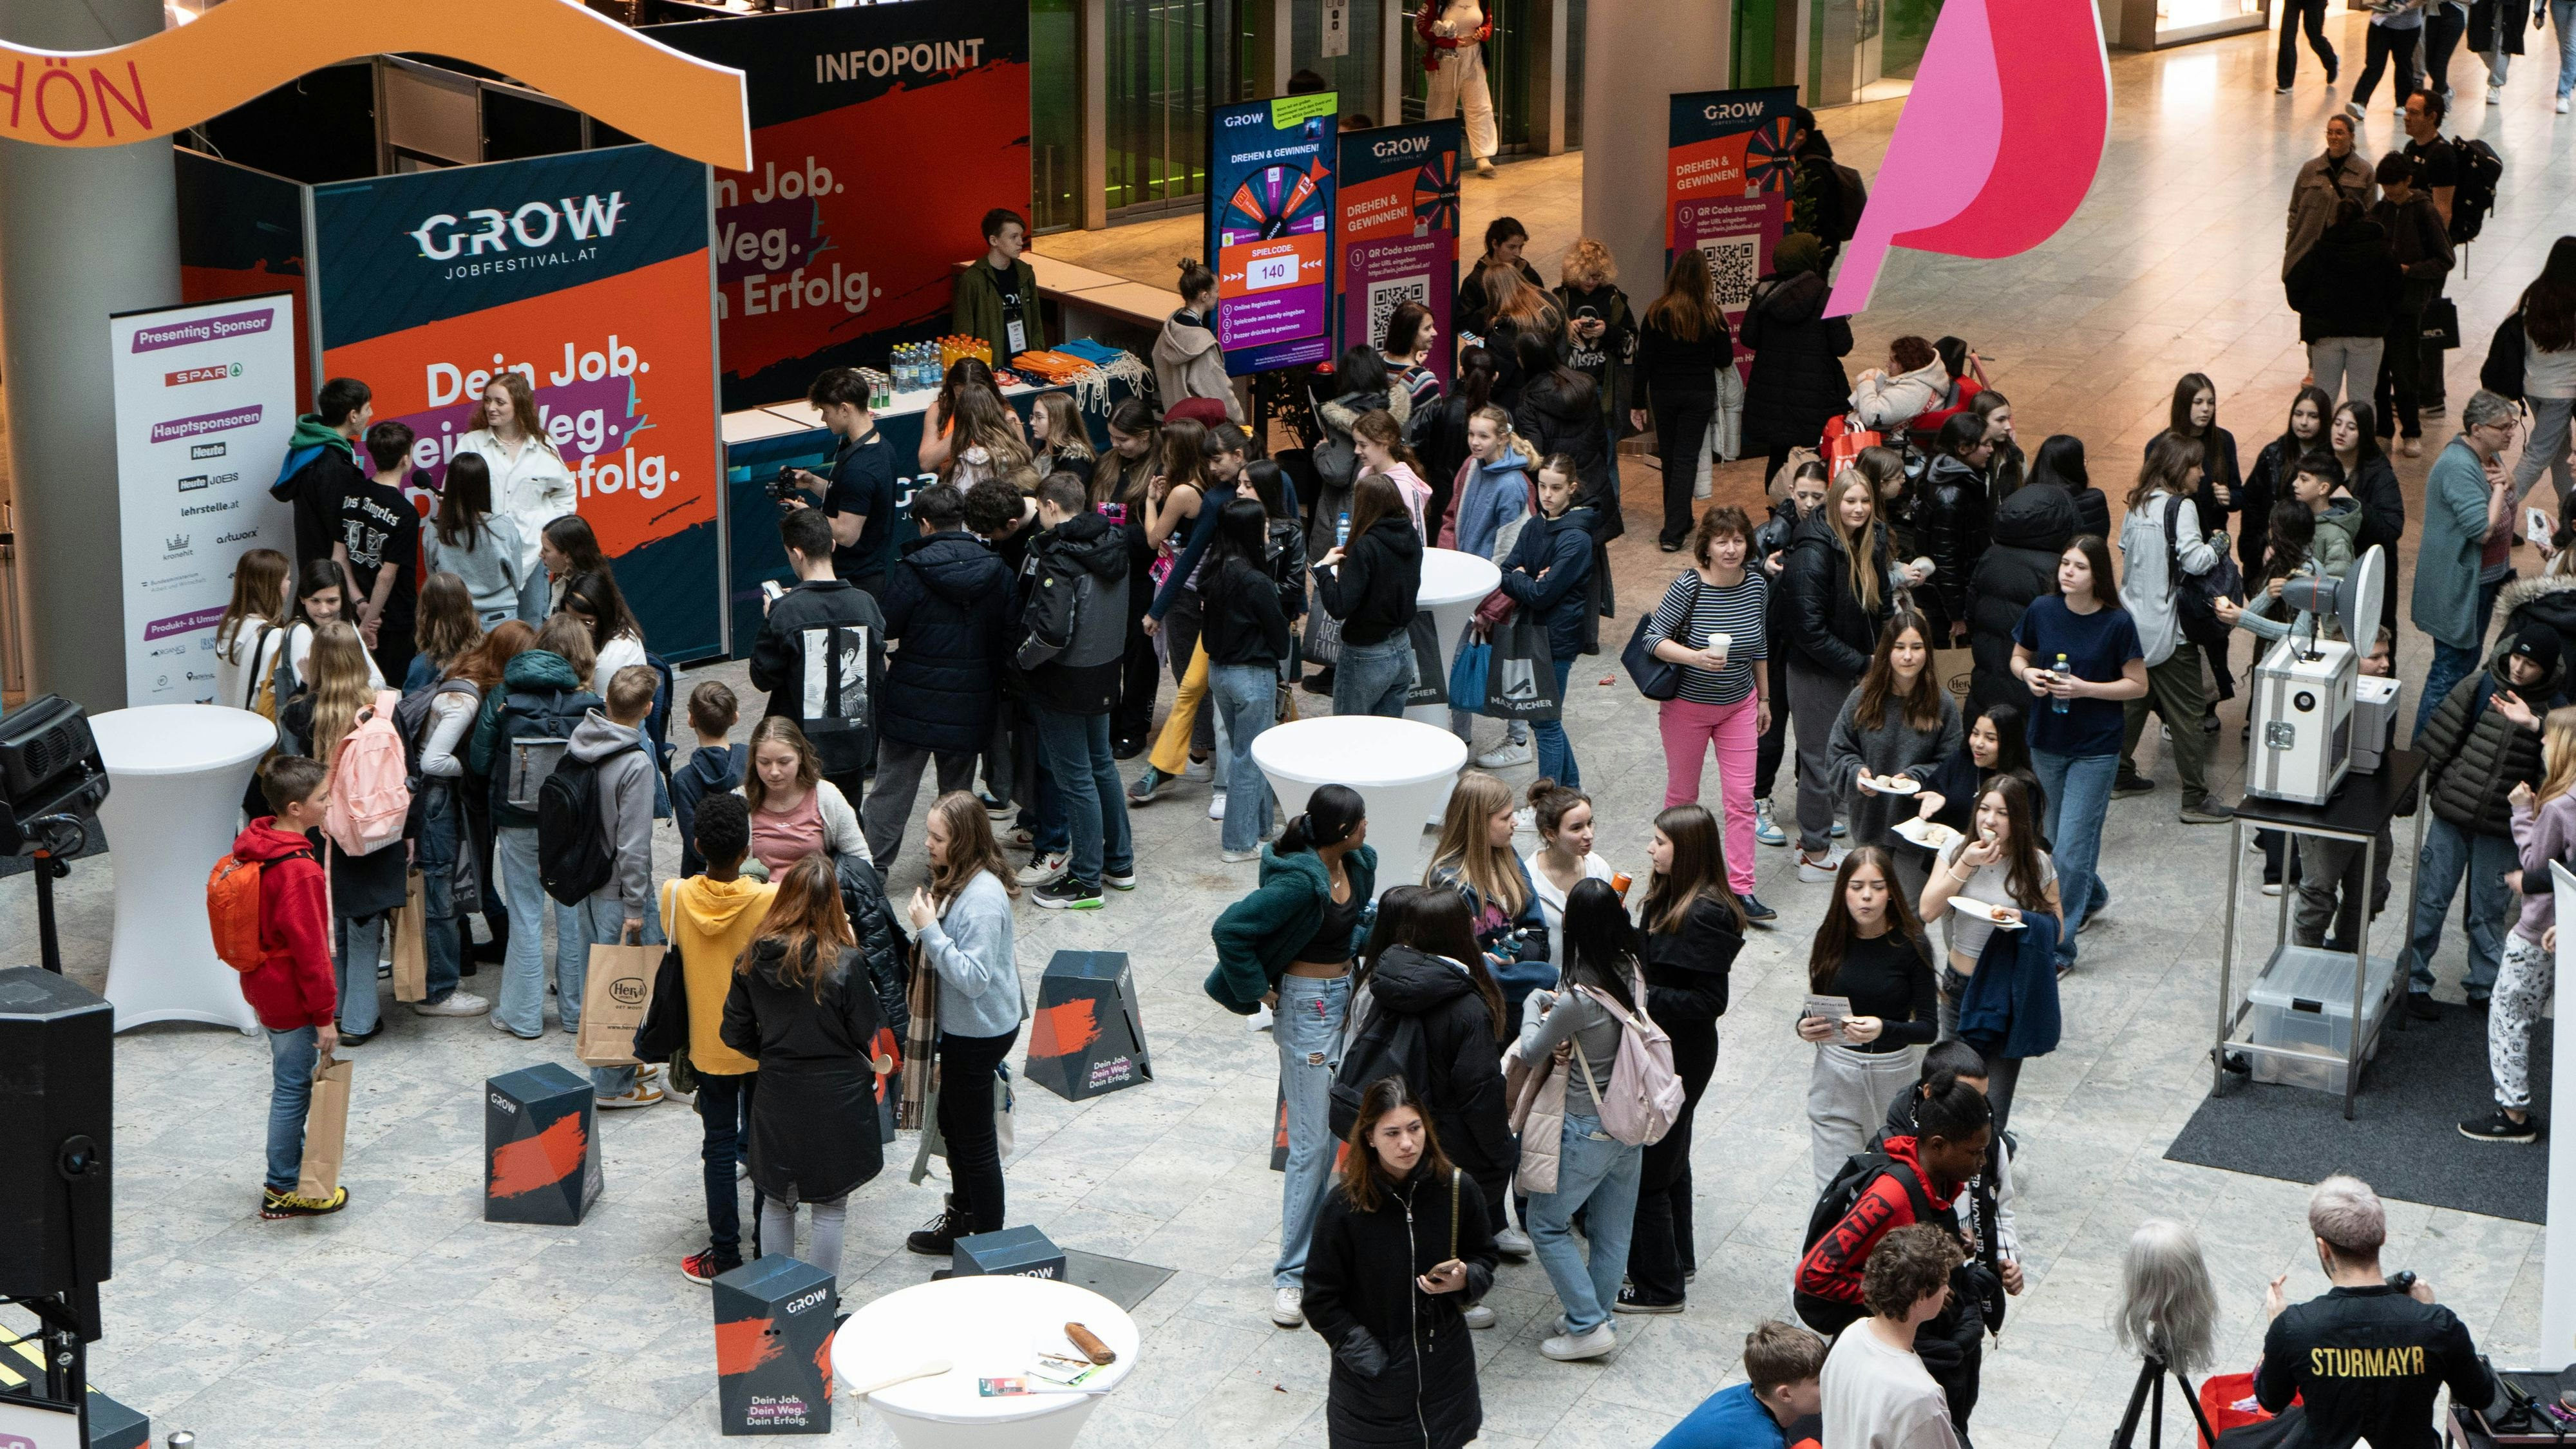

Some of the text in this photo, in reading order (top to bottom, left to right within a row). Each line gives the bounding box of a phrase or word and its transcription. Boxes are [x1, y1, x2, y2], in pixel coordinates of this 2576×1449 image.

[816, 38, 984, 83] INFOPOINT
[1703, 101, 1764, 119] GROW
[1224, 113, 1264, 127] GROW
[1231, 144, 1319, 163] DREHEN & GEWINNEN!
[1372, 136, 1430, 156] GROW
[1676, 156, 1728, 176] DREHEN &
[752, 156, 844, 204] Job.
[1677, 168, 1739, 190] GEWINNEN!
[1347, 194, 1397, 217] DREHEN &
[1698, 207, 1710, 216] QR
[1712, 205, 1732, 214] Code
[1734, 204, 1766, 213] scannen
[410, 191, 629, 260] GROW
[1348, 206, 1408, 232] GEWINNEN!
[1252, 244, 1294, 257] SPIELCODE:
[1368, 249, 1380, 258] QR
[1382, 246, 1403, 256] Code
[1404, 242, 1435, 252] scannen
[444, 248, 598, 279] JOBFESTIVAL.AT
[1262, 264, 1284, 279] 140
[744, 263, 882, 316] Erfolg.
[1251, 299, 1281, 308] Registrieren
[1234, 316, 1256, 326] Spielcode
[1283, 308, 1305, 317] eingeben
[140, 317, 267, 345] Presenting Sponsor
[1251, 328, 1271, 336] drücken
[1276, 324, 1300, 333] gewinnen
[550, 335, 650, 386] Job.
[176, 367, 227, 383] SPAR
[154, 412, 259, 437] Hauptsponsoren
[193, 444, 224, 459] Heute
[180, 473, 239, 489] Heute JOBS
[571, 447, 680, 498] folg.
[181, 500, 239, 516] lehrstelle.at
[363, 497, 400, 526] Angeles
[216, 527, 258, 544] artworx
[163, 549, 193, 560] kronehit
[151, 620, 186, 634] Produkt-
[196, 614, 224, 624] Umset
[1317, 621, 1340, 643] ARE
[1314, 639, 1341, 663] FAMI
[1408, 688, 1437, 699] CHER
[1490, 696, 1553, 711] MAX AICHER
[1092, 1065, 1130, 1079] Dein Weg.
[1094, 1056, 1128, 1070] Dein Job.
[1089, 1072, 1132, 1088] Dein Erfolg.
[491, 1093, 516, 1114] GROW
[1836, 1197, 1889, 1255] AIR
[1971, 1197, 1985, 1253] MONCLER
[786, 1288, 827, 1314] GROW
[2311, 1345, 2425, 1378] STURMAYR
[752, 1395, 802, 1405] Dein Job.
[750, 1406, 804, 1416] Dein Weg.
[747, 1416, 809, 1426] Dein Erfolg.
